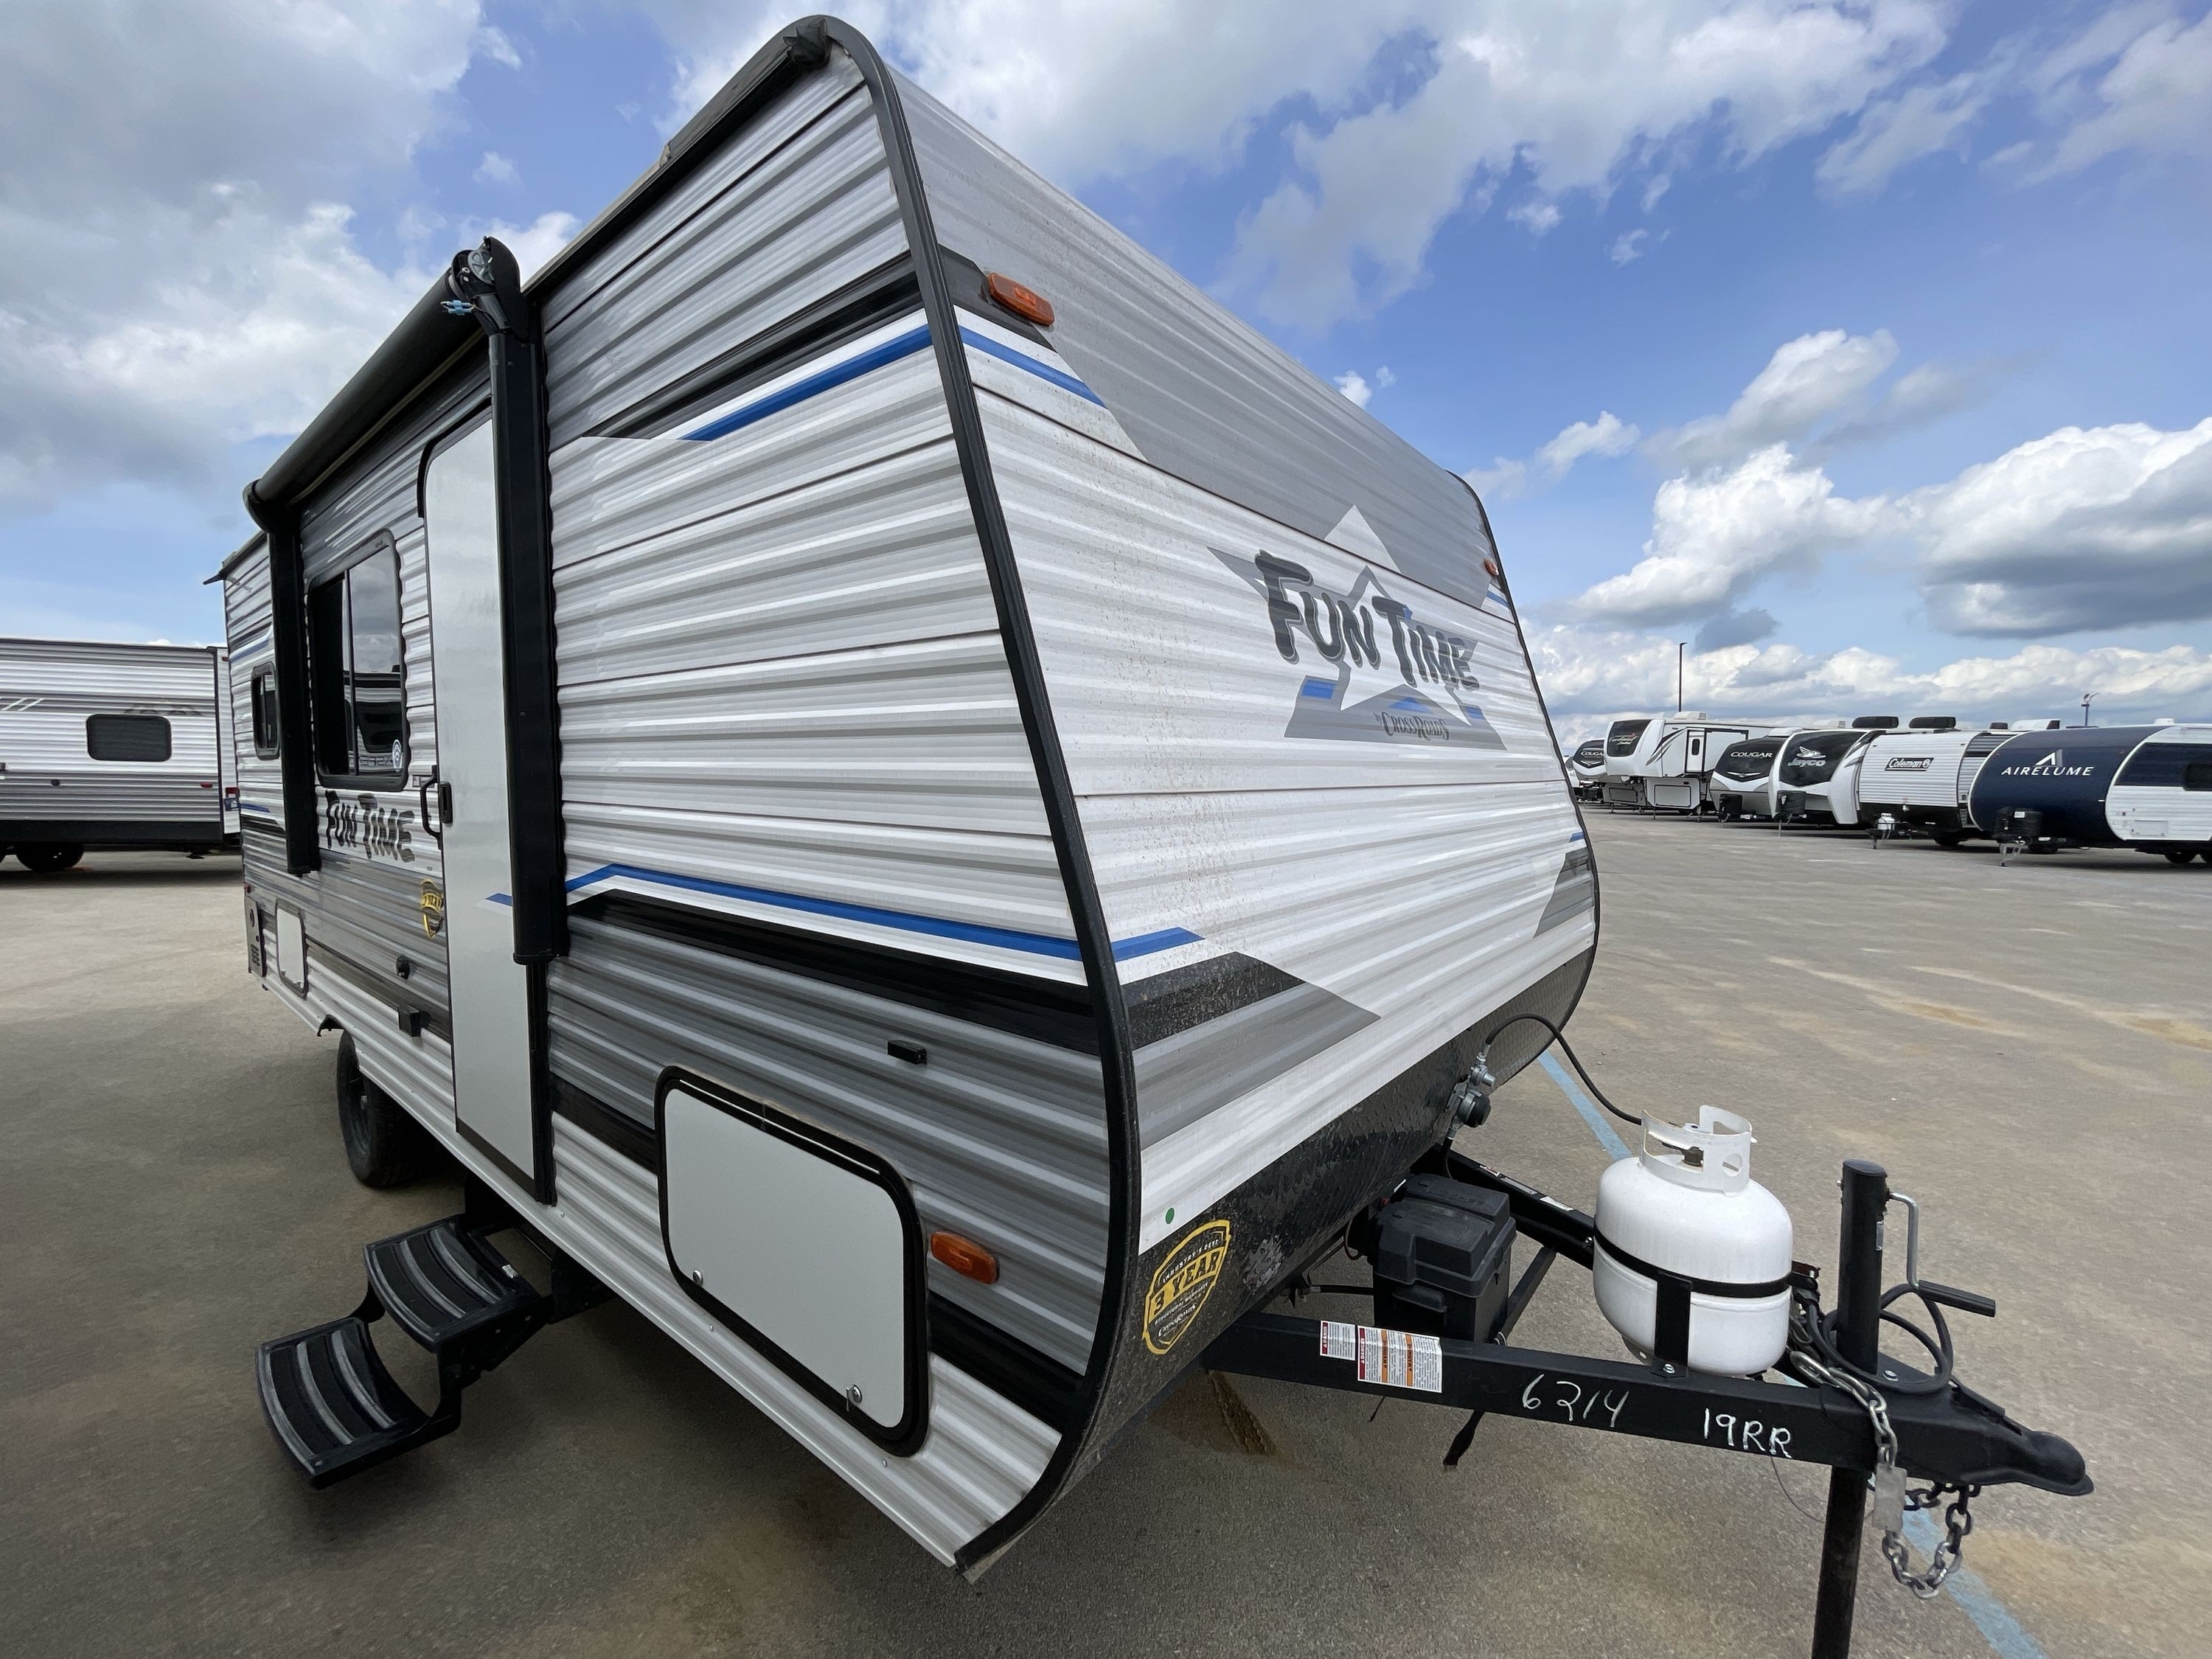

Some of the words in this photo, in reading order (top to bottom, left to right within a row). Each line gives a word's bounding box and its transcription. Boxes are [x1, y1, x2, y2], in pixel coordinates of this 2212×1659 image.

[1254, 549, 1381, 670] FUN
[1371, 595, 1480, 692] TIME
[1787, 758, 1826, 768] Jayco
[1888, 758, 1923, 768] Coleman
[2001, 766, 2094, 776] AIRELUME
[325, 789, 358, 849] FUN
[1154, 1290, 1165, 1315] 3
[1172, 1251, 1221, 1297] YEAR
[1703, 1408, 1792, 1458] 19RR
